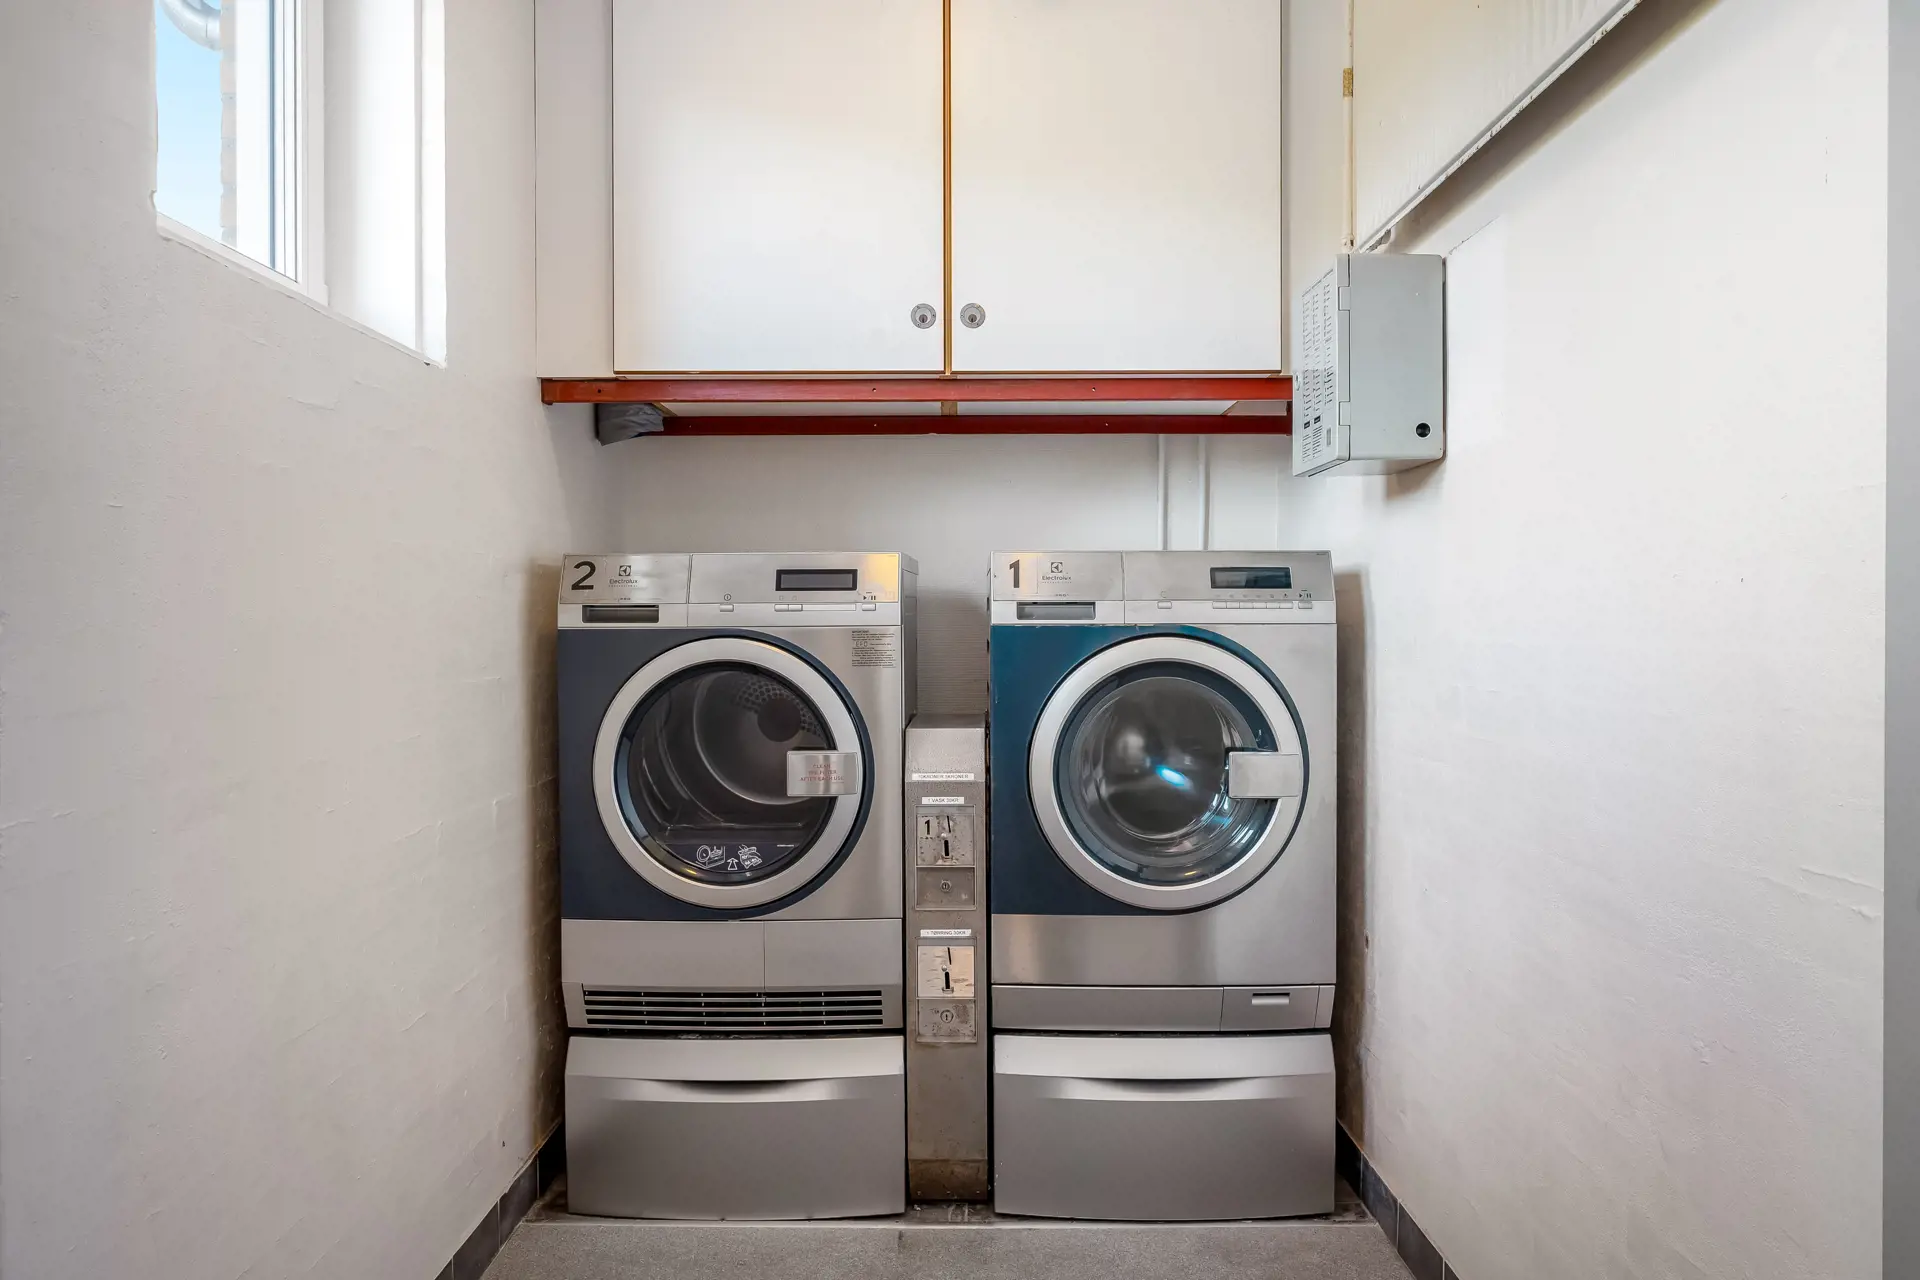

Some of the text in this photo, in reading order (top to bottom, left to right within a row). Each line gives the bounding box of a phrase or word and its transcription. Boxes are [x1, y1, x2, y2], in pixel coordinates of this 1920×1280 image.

[571, 560, 596, 590] 2
[1009, 559, 1020, 588] 1
[924, 819, 931, 835] 1
